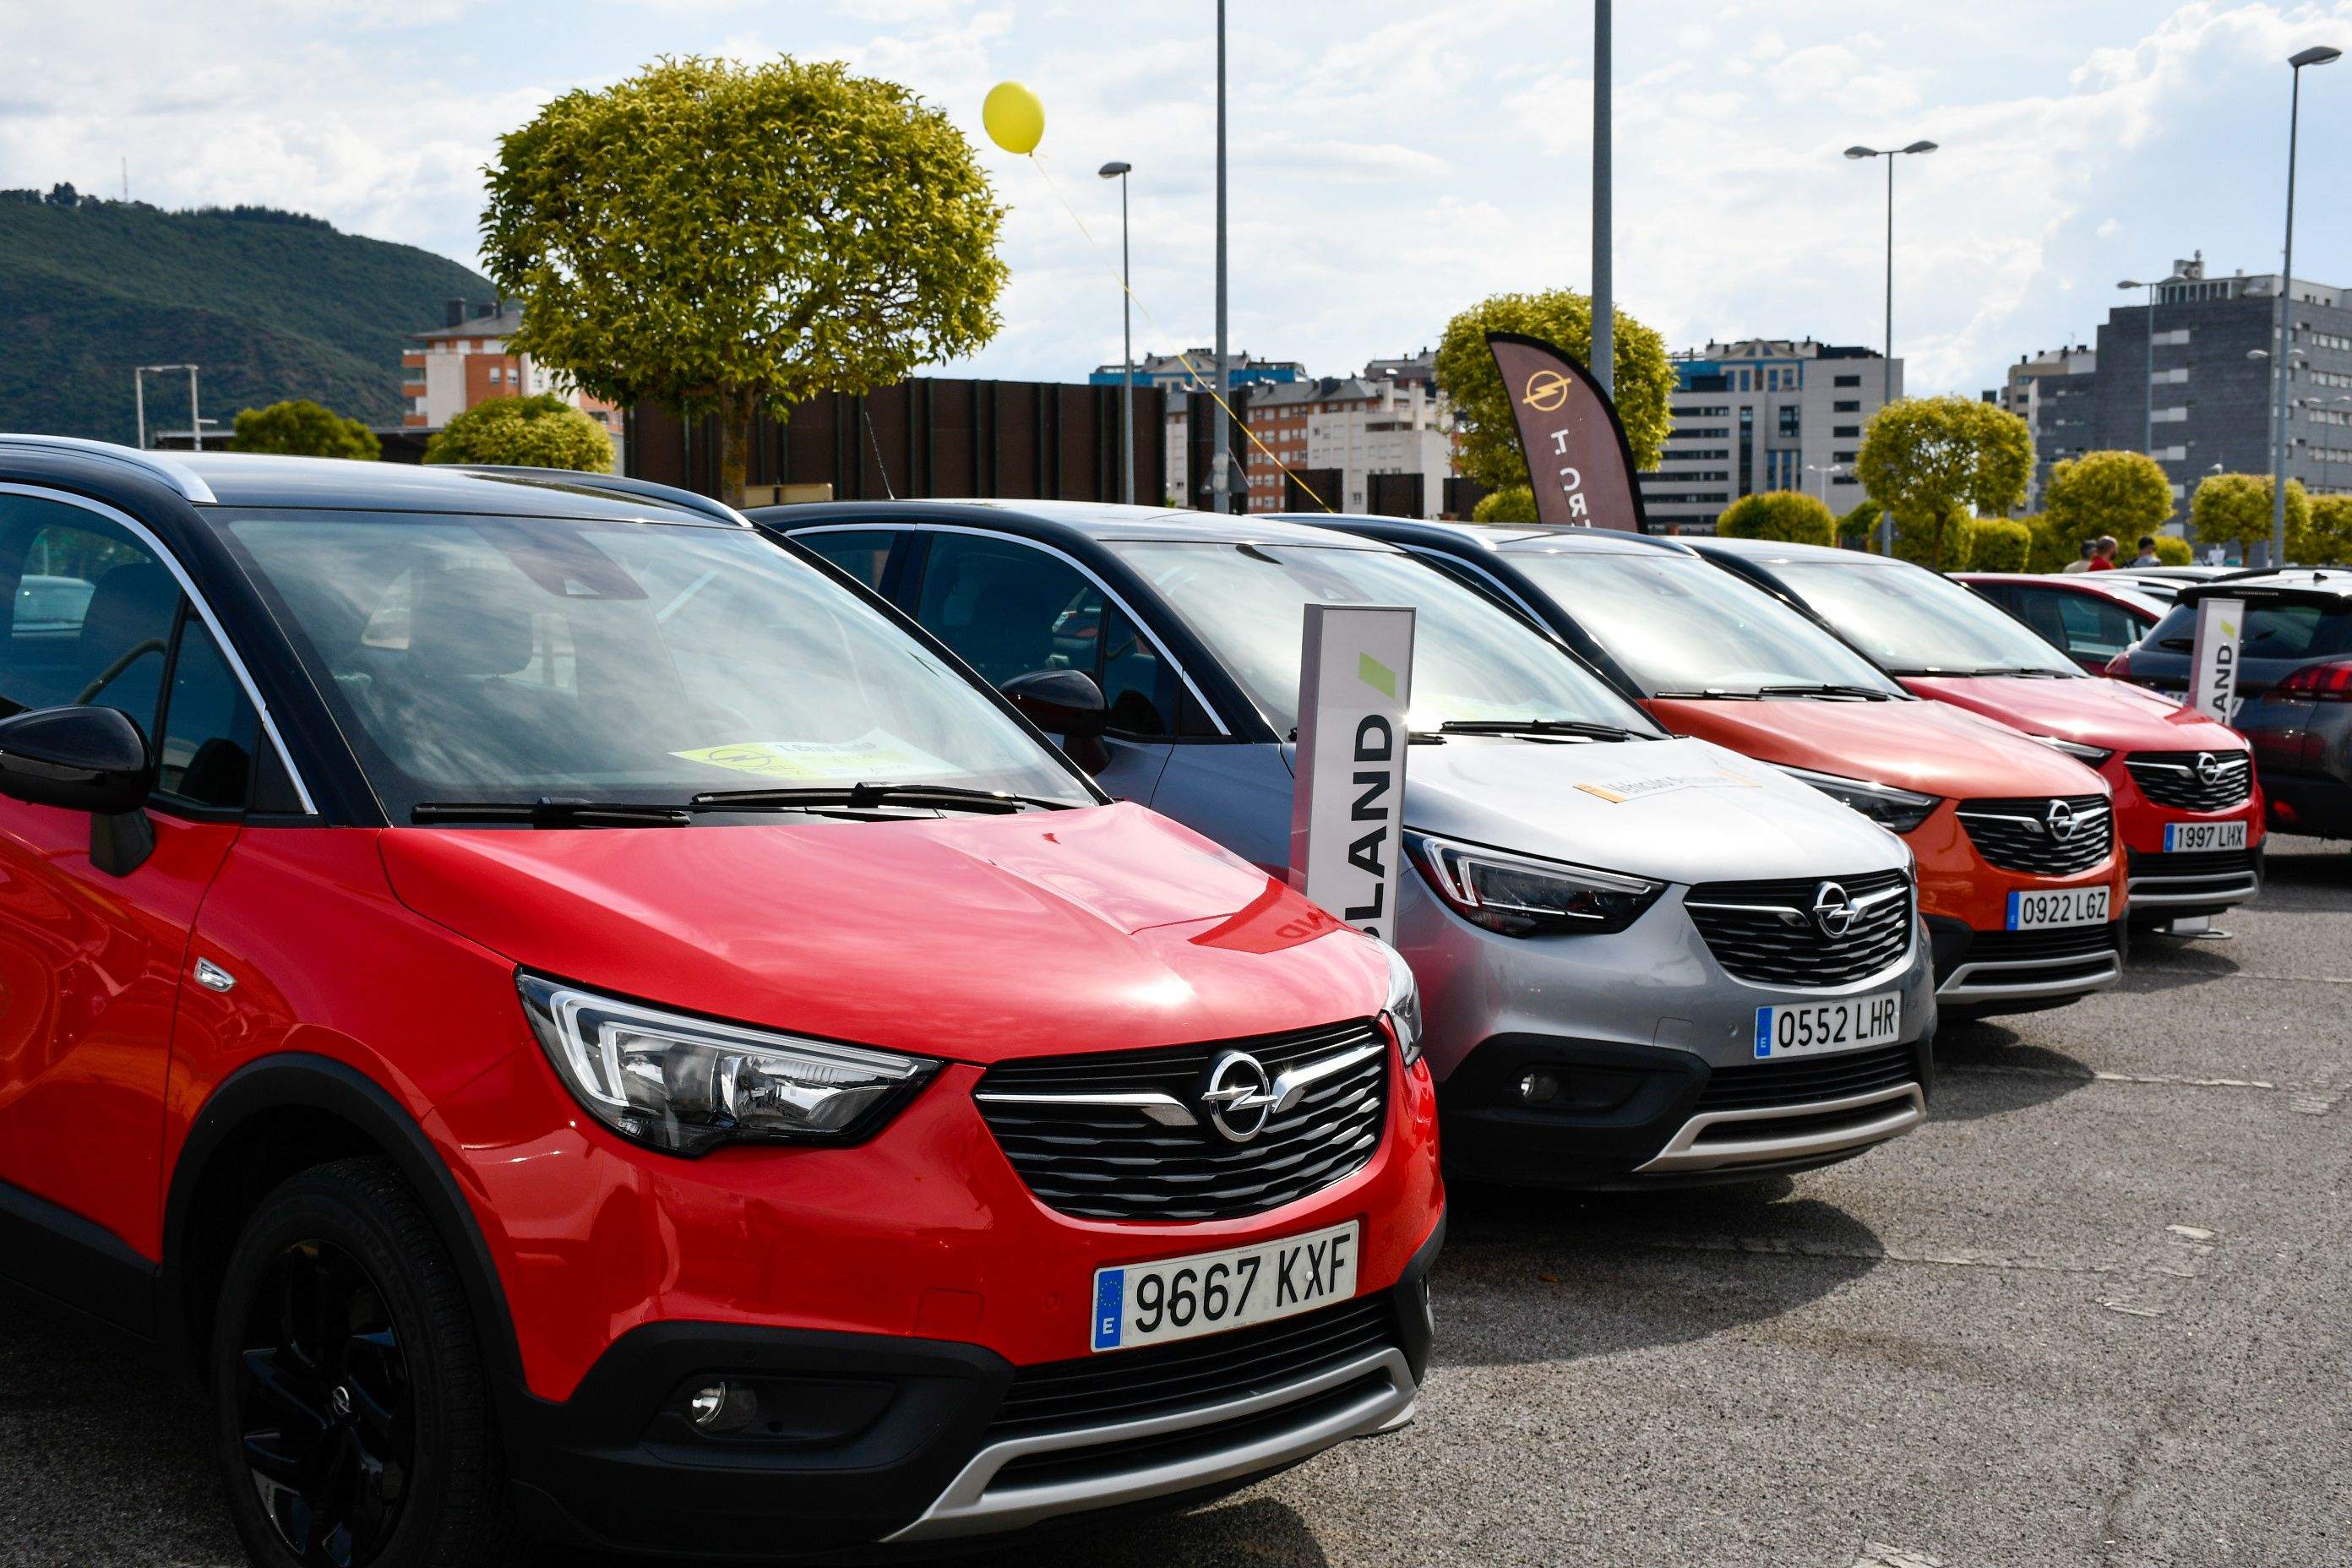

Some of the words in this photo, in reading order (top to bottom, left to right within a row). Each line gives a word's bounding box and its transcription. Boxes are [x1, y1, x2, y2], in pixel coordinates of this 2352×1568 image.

[2213, 645, 2233, 723] AND
[1345, 714, 1392, 939] LAND
[2178, 826, 2215, 847] 1997
[2219, 825, 2244, 847] LHX
[2023, 896, 2071, 923] 0922
[2076, 892, 2106, 921] LGZ
[1760, 1037, 1767, 1048] E
[1778, 1006, 1848, 1048] 0552
[1856, 999, 1895, 1039] LHR
[1102, 1317, 1115, 1335] E
[1135, 1256, 1260, 1332] 9667
[1277, 1233, 1350, 1307] KXF
